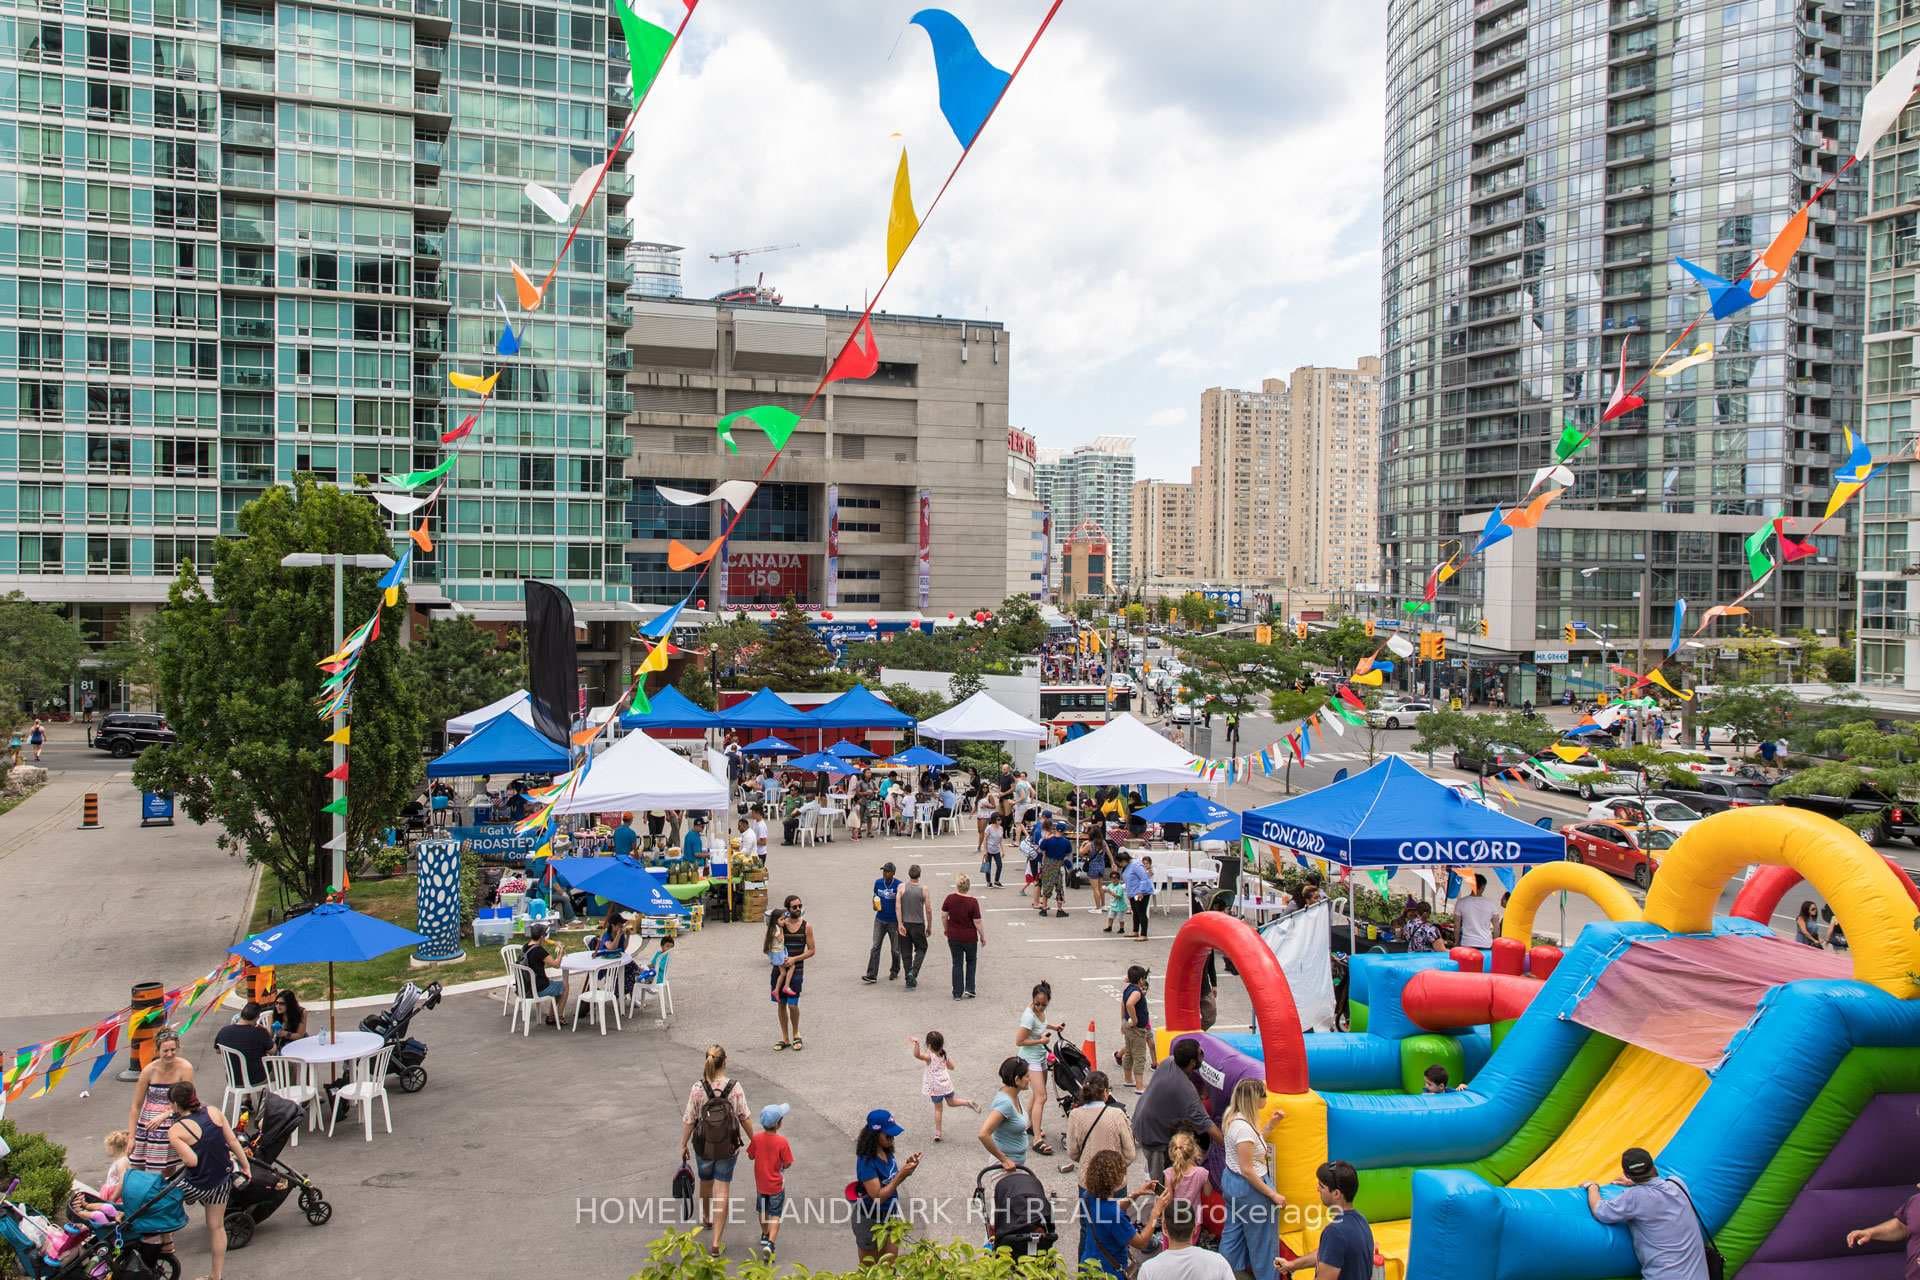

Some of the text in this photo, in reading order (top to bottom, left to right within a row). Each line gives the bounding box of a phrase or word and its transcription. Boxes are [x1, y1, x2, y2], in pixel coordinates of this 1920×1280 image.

[728, 552, 801, 568] CANADA
[748, 570, 780, 586] 150
[81, 680, 94, 690] 81
[473, 837, 535, 850] ROASTED
[1262, 821, 1326, 853] CONCORD
[1398, 840, 1521, 861] CONCORD
